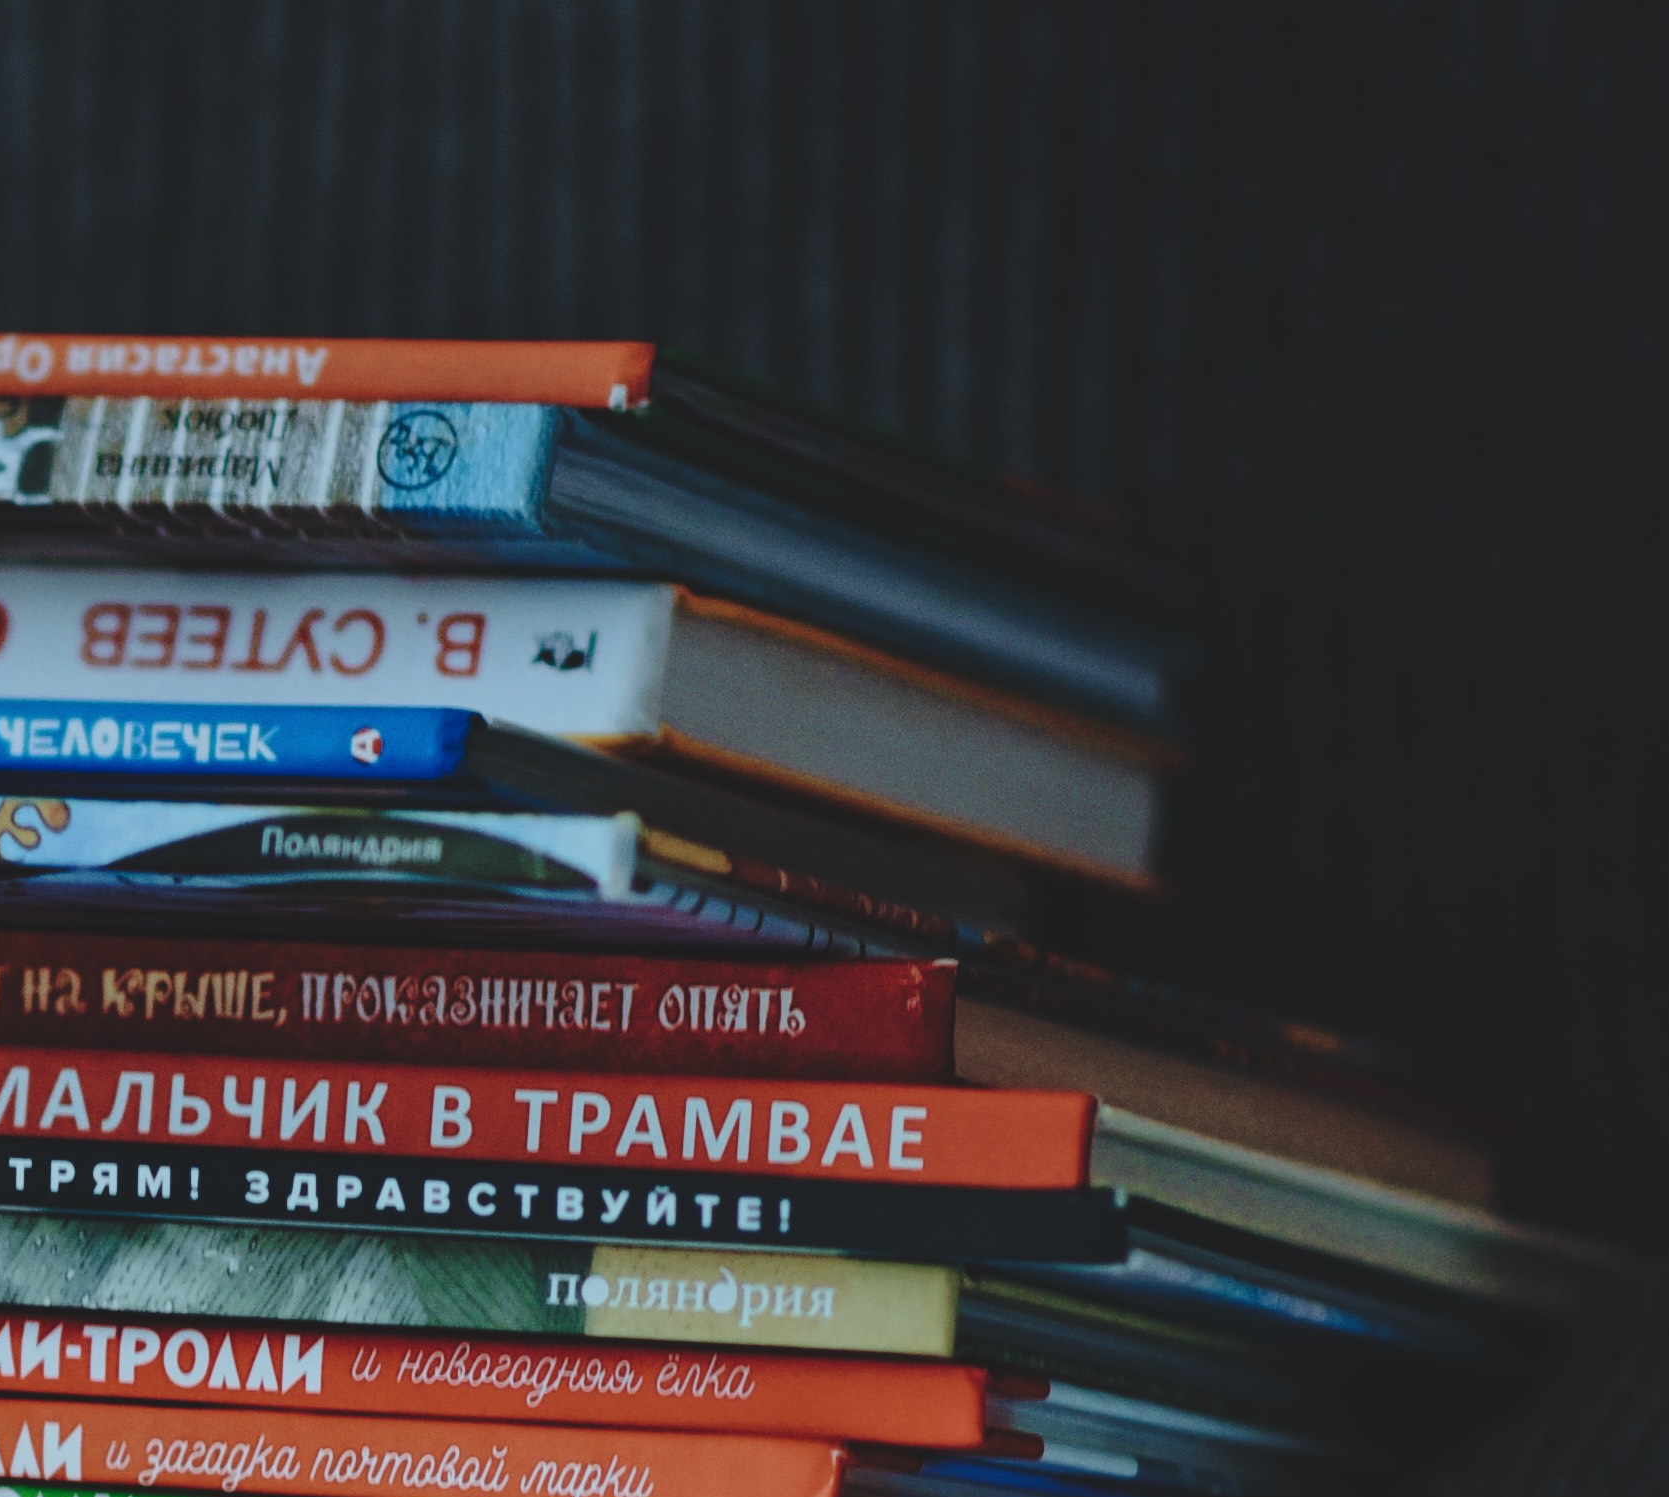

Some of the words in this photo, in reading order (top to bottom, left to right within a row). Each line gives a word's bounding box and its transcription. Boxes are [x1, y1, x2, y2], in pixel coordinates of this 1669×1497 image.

[68, 343, 328, 386] Анастасия
[80, 602, 385, 676] СУТЕЕВ
[419, 613, 486, 677] В.
[261, 826, 443, 867] Поляндрия
[659, 984, 806, 1035] ОПЯТЬ
[430, 1086, 473, 1148] В
[515, 1088, 927, 1171] ТРАМВАЕ
[8, 1157, 203, 1201] ТРЯМ!
[245, 1170, 793, 1234] ЗДРАВСТВУЙТЕ!
[351, 1346, 381, 1382] и
[397, 1341, 643, 1407] новогодняя
[105, 1438, 130, 1470] и
[138, 1436, 299, 1491] загадка
[310, 1448, 509, 1496] почтовой
